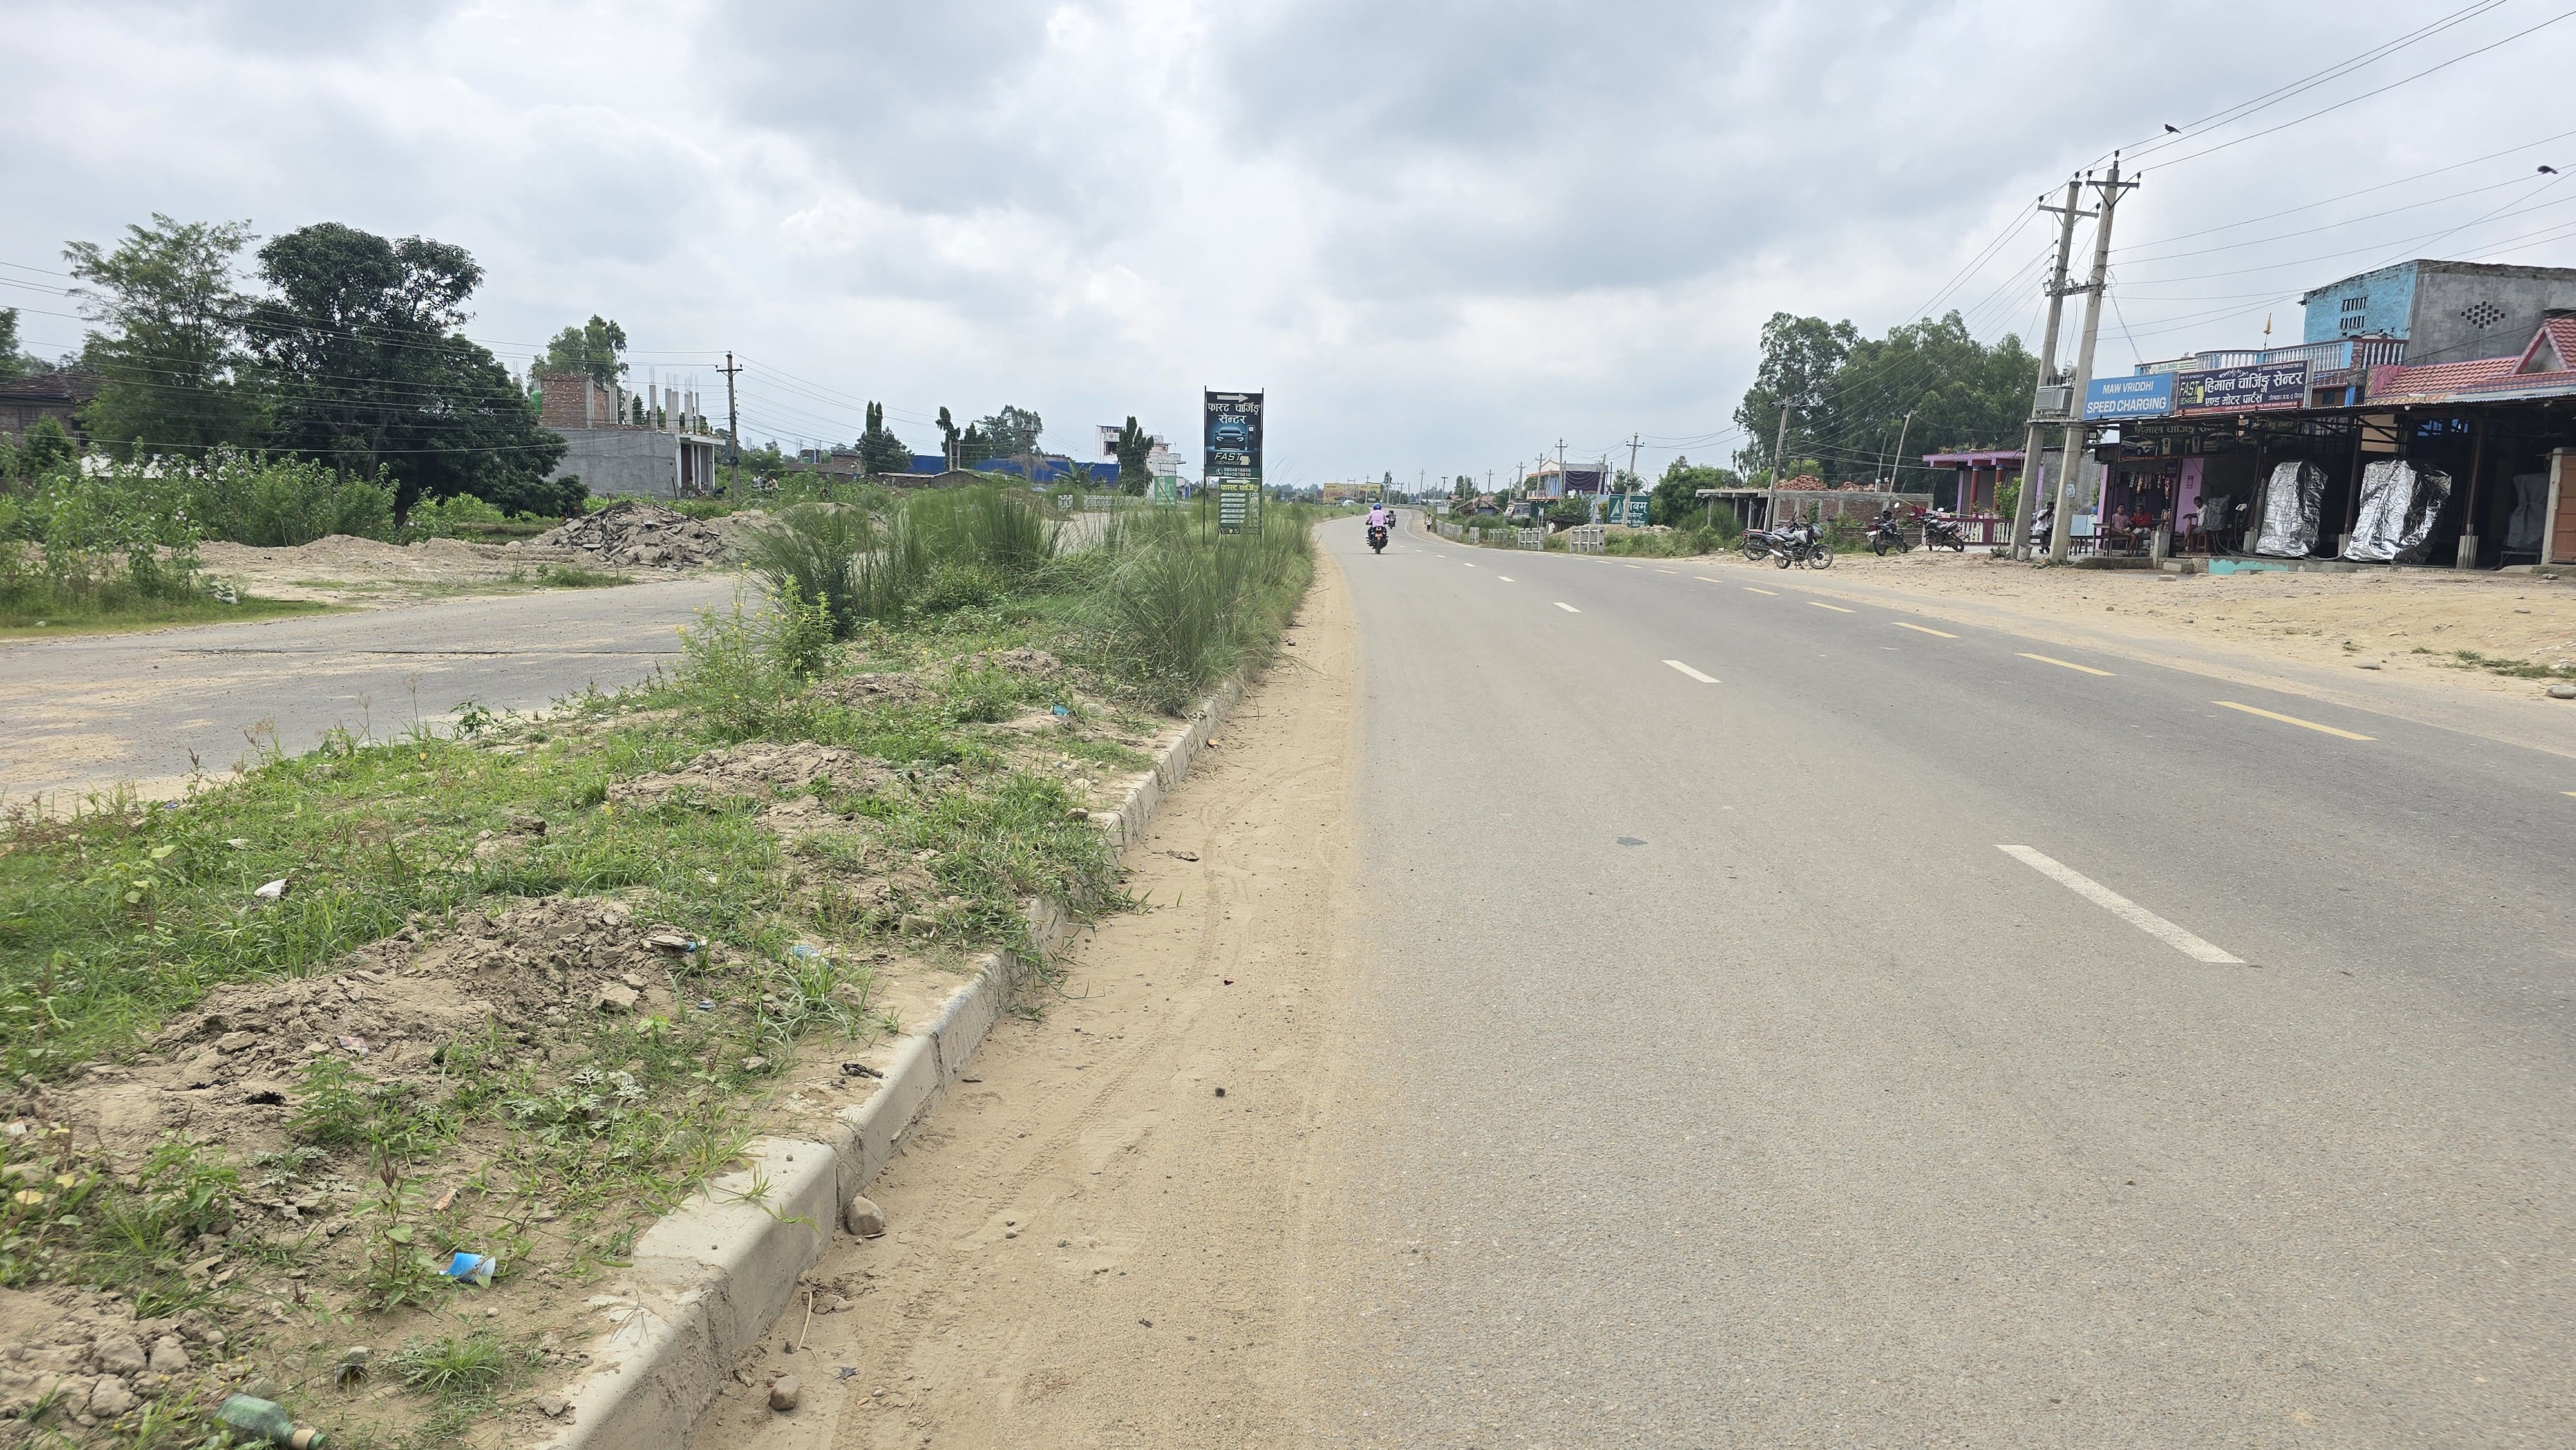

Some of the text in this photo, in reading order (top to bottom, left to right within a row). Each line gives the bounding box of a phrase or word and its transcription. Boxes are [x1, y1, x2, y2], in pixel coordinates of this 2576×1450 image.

[2102, 381, 2154, 395] MAW VRIDDHI
[2179, 381, 2200, 396] FAST
[2204, 377, 2235, 393] हिमाल
[2273, 371, 2304, 387] सेन्टर
[2087, 400, 2116, 414] SPEED
[2117, 397, 2167, 412] CHARGING
[2221, 393, 2242, 406] मोटर
[1208, 403, 1230, 412] फास्ट
[1218, 413, 1247, 424] सेन्टर
[1215, 453, 1243, 461] FAST
